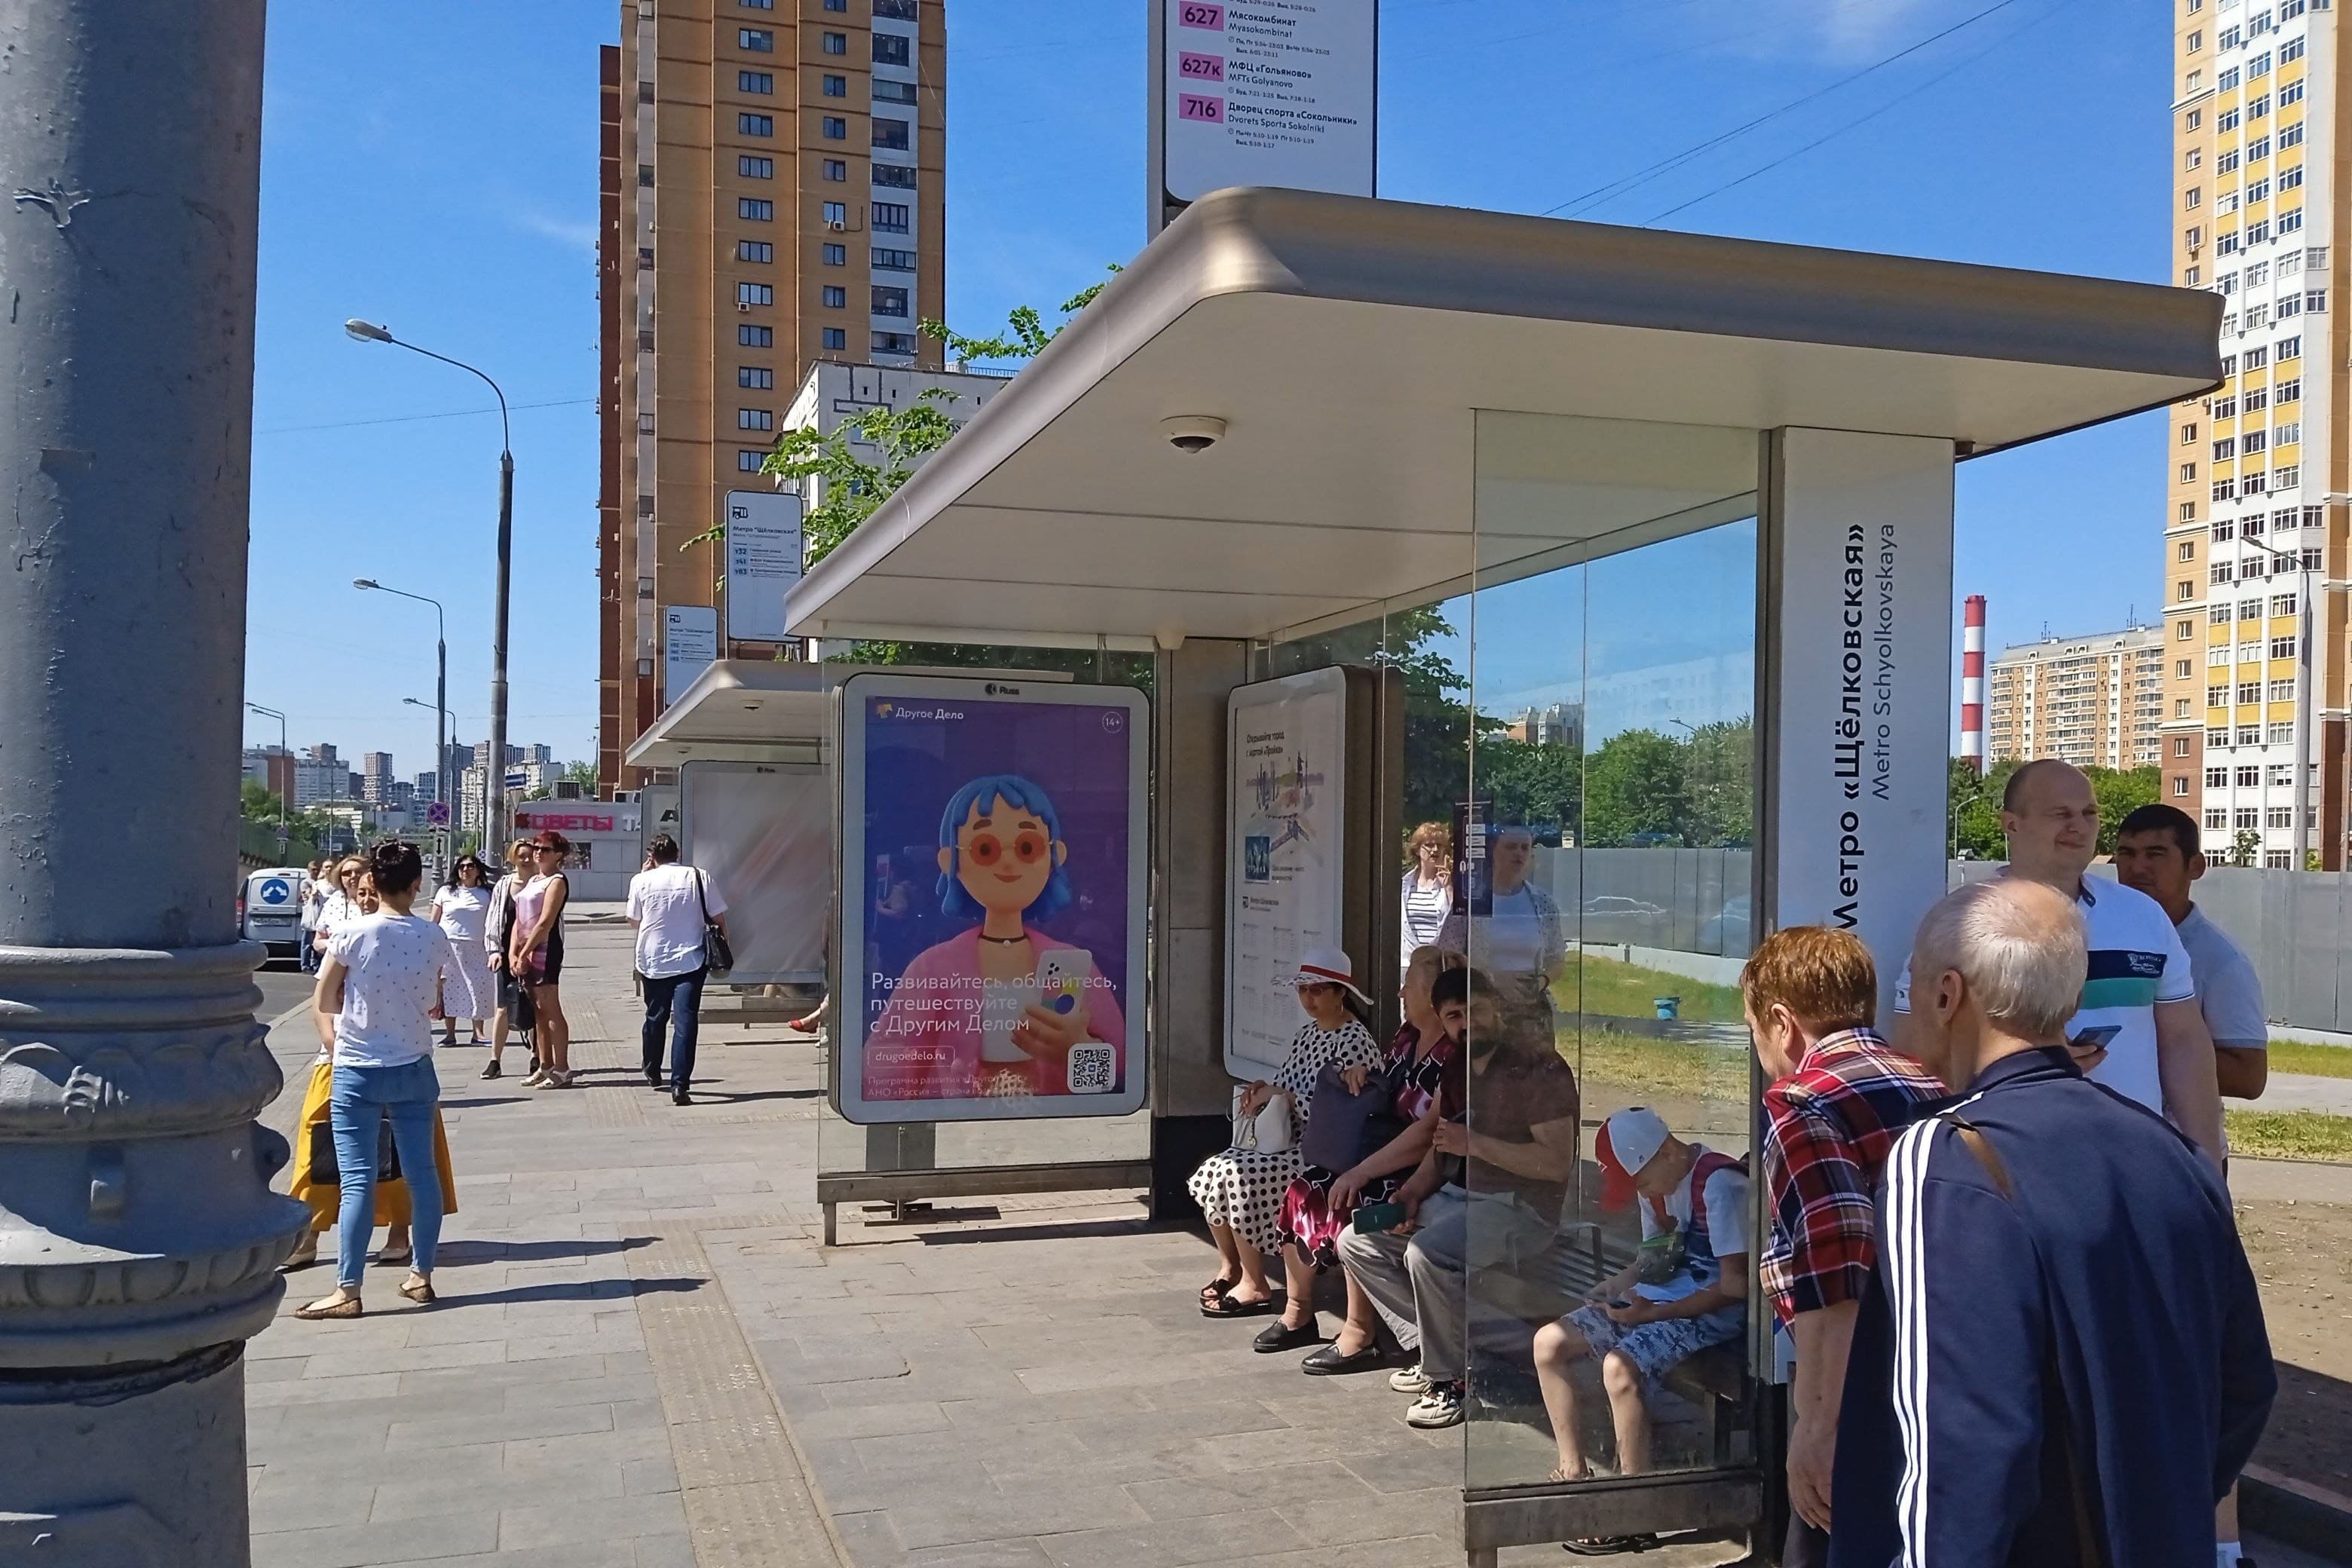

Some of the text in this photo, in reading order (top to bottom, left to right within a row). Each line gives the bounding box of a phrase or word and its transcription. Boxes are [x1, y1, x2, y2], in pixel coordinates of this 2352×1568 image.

[1184, 7, 1218, 25] 627
[1229, 10, 1297, 26] Мясокомбинат
[1229, 23, 1292, 38] Myasokombinat
[1182, 58, 1221, 75] 627к
[1229, 61, 1312, 78] МФЦ «Гольяново»
[1229, 74, 1294, 88] MFTs Golyanovo
[1187, 99, 1216, 118] 716
[1228, 102, 1358, 125] Дворец спорта «Сокольники»
[1228, 115, 1325, 133] Dvorets Sporta Sokolniki
[1835, 523, 1865, 798] «Щёлковская»
[1873, 523, 1898, 801] Metro Schyolkovskaya
[1000, 686, 1020, 696] Russ
[896, 707, 964, 721] Другое Дело
[1105, 717, 1121, 727] 14+
[531, 814, 613, 831] ЦВЕТЫ
[871, 972, 1116, 991] Развивайтесь, общайтесь,
[870, 995, 1018, 1015] путешествуйте
[870, 1015, 1030, 1036] с Другим Делом
[875, 1052, 946, 1063] drugoedelo.ru
[868, 1076, 918, 1086] Программа
[868, 1088, 891, 1097] АНО
